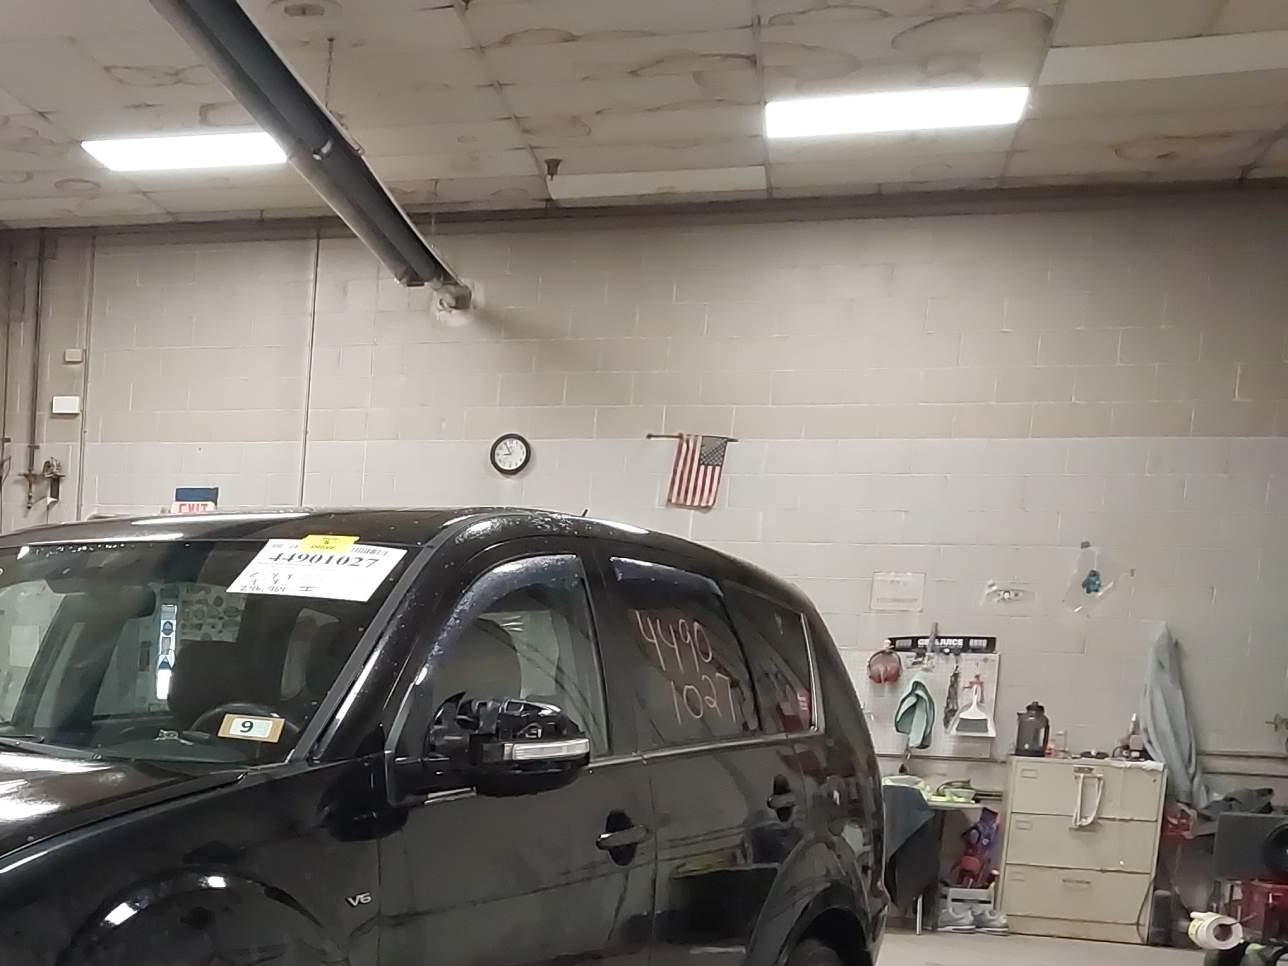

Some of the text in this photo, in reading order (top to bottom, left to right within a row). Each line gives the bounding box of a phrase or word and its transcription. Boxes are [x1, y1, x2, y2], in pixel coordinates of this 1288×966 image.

[268, 552, 381, 569] 44901027
[634, 609, 714, 673] 4490
[671, 672, 737, 726] 1027
[240, 720, 254, 733] 9
[346, 892, 372, 906] V6
